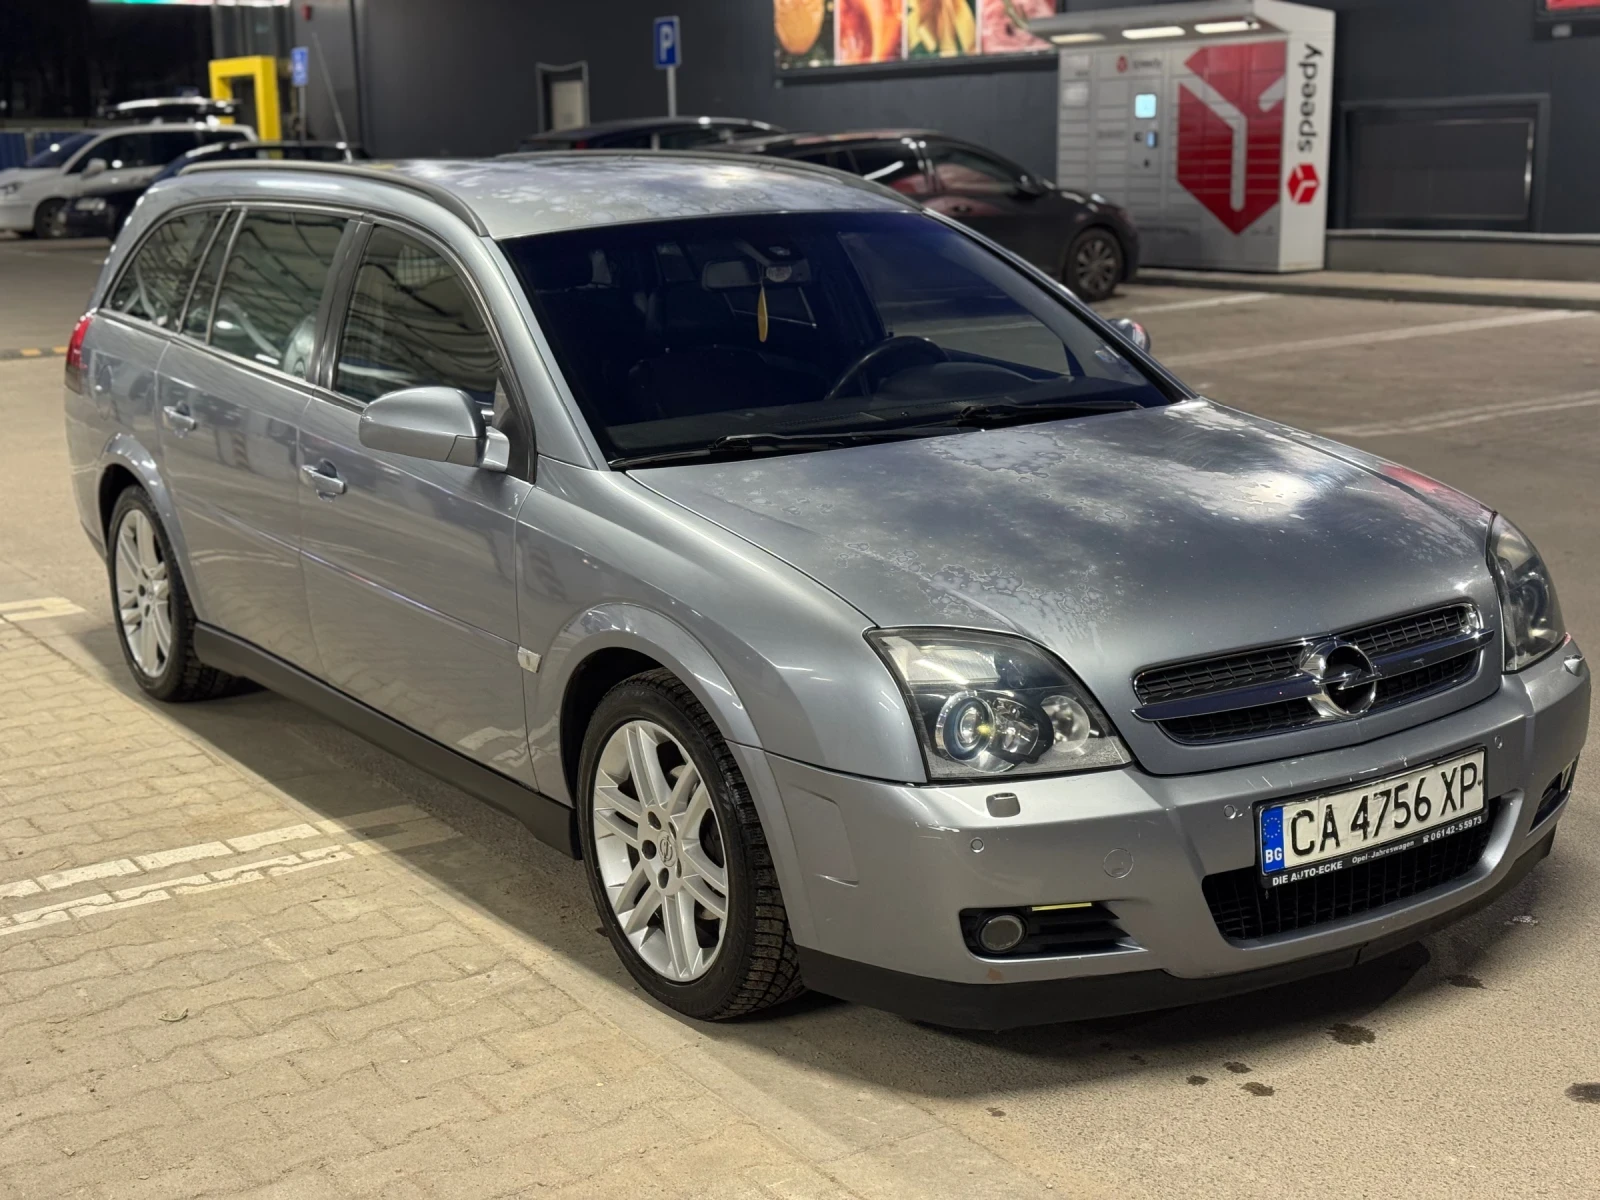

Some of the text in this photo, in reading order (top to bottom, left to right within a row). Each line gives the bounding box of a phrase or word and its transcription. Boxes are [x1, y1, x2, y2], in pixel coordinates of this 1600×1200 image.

[660, 24, 674, 62] P
[1297, 43, 1323, 153] speedy
[1290, 761, 1478, 857] CA 4756 XP
[1265, 847, 1283, 863] BG
[1272, 875, 1288, 886] DIE
[1290, 860, 1343, 882] AUTO-ECKE
